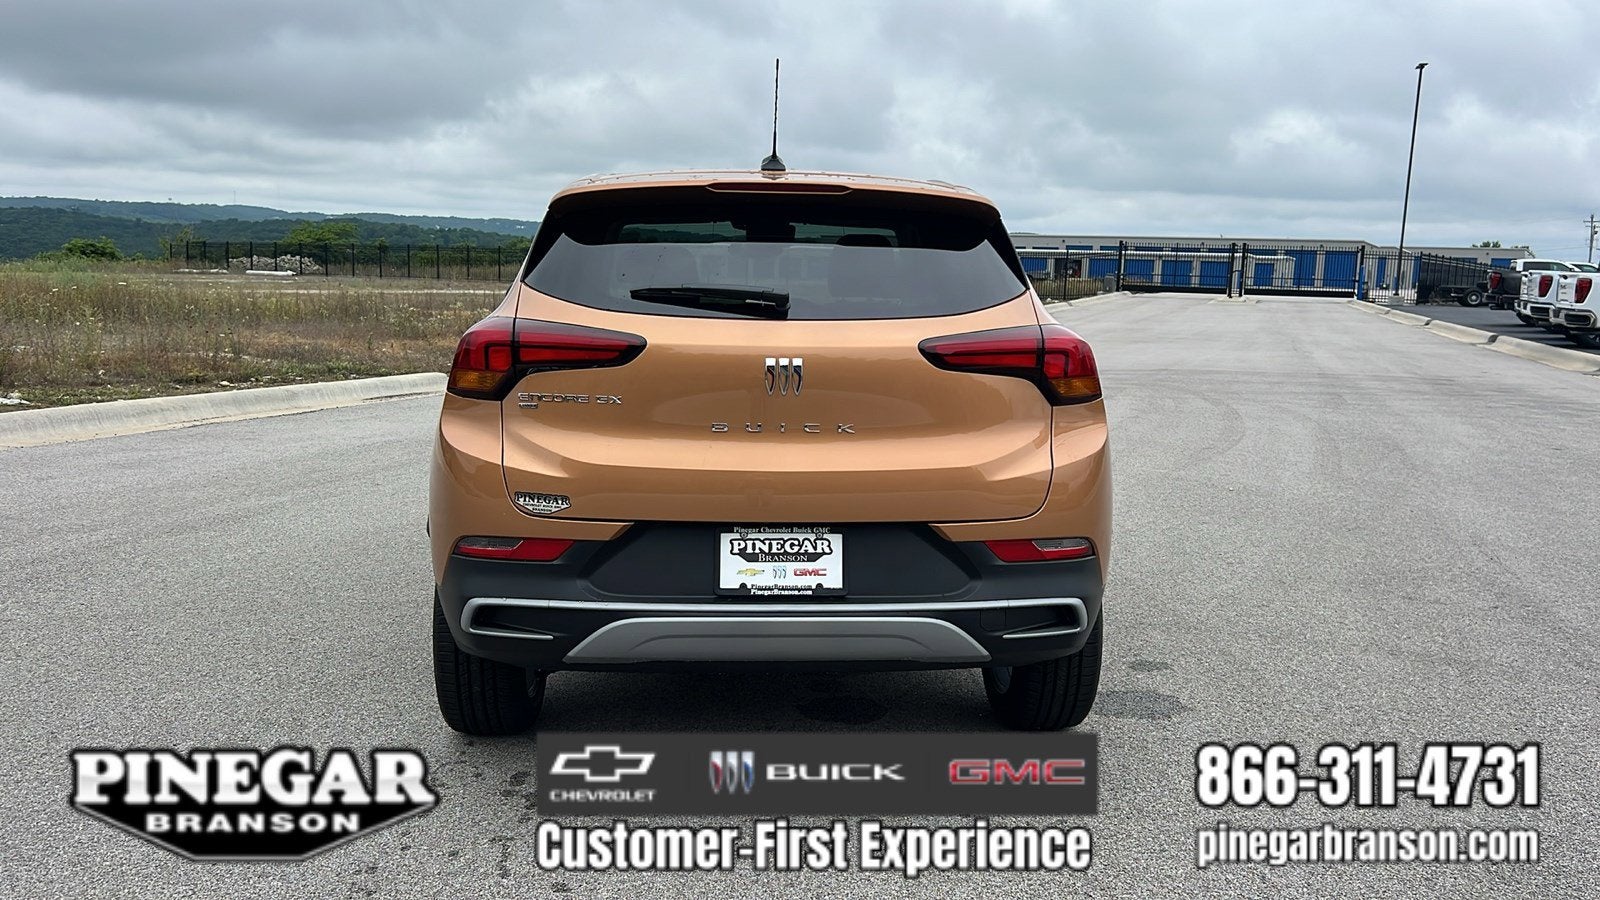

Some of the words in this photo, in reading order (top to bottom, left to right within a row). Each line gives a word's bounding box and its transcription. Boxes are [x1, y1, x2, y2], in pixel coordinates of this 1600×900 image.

[518, 392, 589, 403] ENCORE
[711, 422, 856, 434] BUICK
[516, 493, 569, 505] PINEGAR
[733, 526, 759, 534] Pinegar
[731, 539, 832, 554] PINEGAR
[793, 568, 827, 577] GMC
